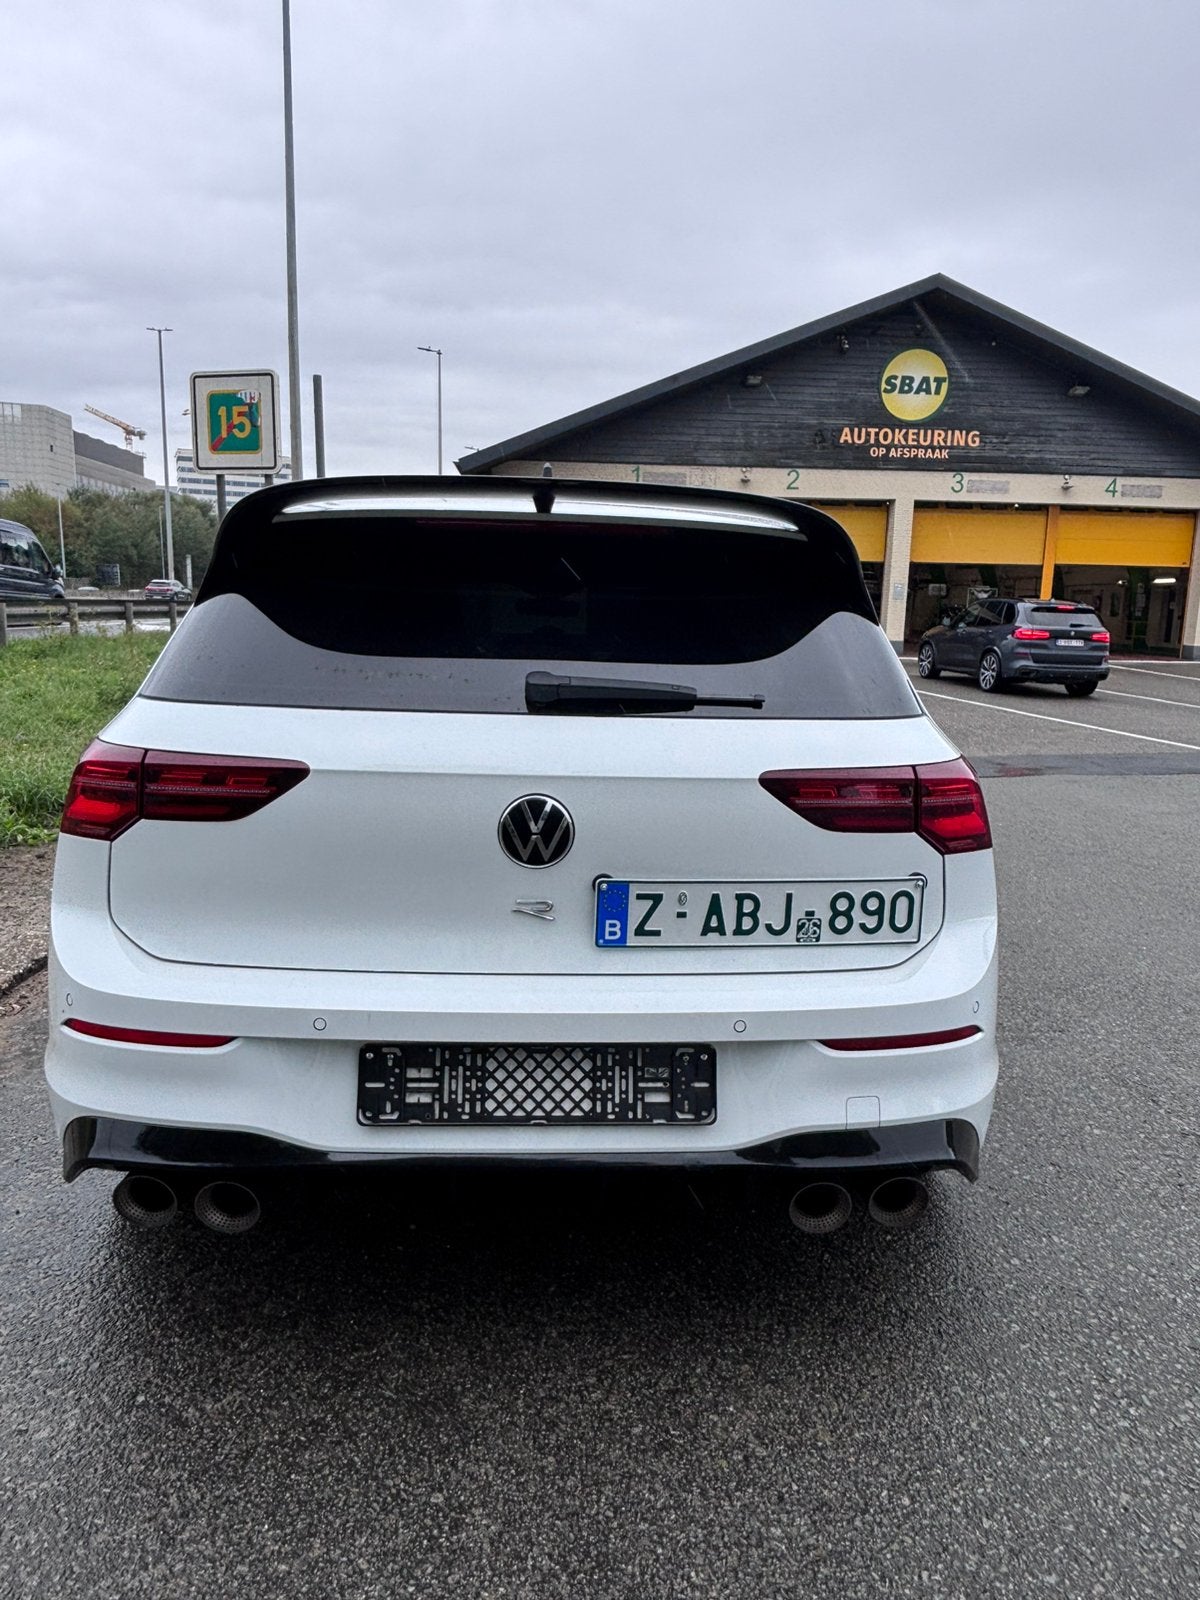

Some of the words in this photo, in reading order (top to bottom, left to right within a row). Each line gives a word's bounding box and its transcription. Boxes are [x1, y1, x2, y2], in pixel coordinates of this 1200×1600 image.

[882, 375, 947, 396] SBAT
[217, 405, 252, 438] 15
[839, 427, 981, 447] AUTOKEURING
[870, 447, 886, 458] OP
[889, 447, 949, 459] AFSPRAAK
[631, 465, 640, 482] 1
[786, 469, 800, 490] 2
[951, 473, 964, 494] 3
[1105, 478, 1118, 498] 4
[604, 920, 621, 940] B
